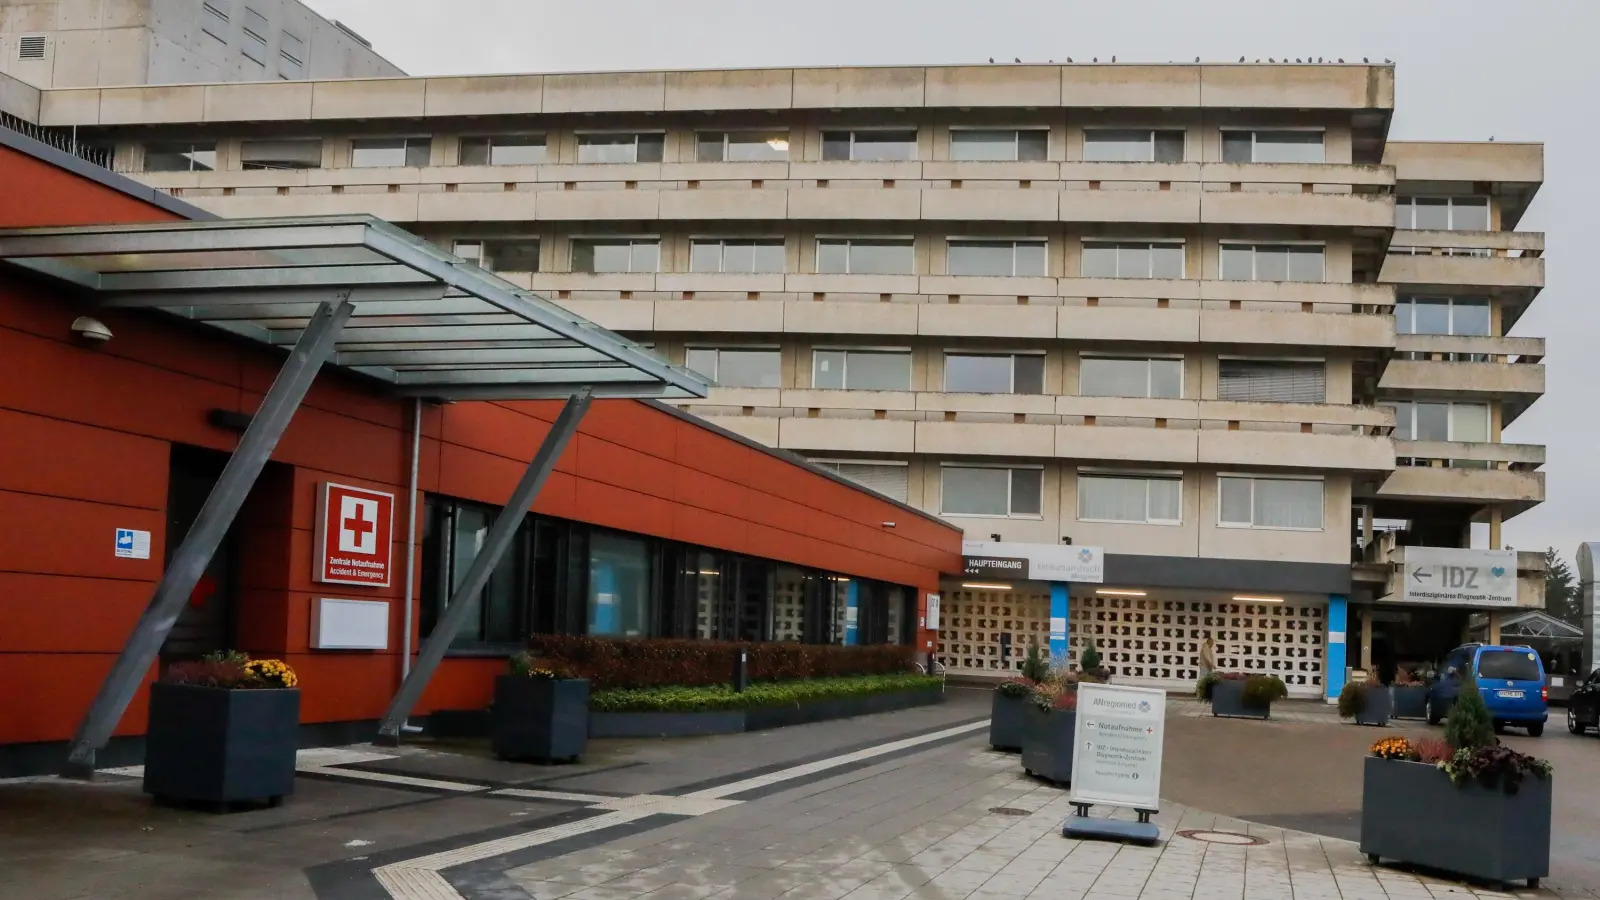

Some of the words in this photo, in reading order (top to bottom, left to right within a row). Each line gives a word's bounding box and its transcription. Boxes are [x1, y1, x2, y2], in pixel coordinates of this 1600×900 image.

[330, 557, 351, 566] Zentrale
[352, 559, 384, 569] Notaufnahme
[968, 559, 1022, 569] HAUPTEINGANG
[330, 567, 351, 576] Accident
[358, 570, 384, 579] Emergency
[1442, 565, 1479, 589] IDZ
[1409, 591, 1456, 600] Interdisziplinäres
[1093, 698, 1137, 709] ANregiomed
[1098, 722, 1143, 733] Notaufnahme
